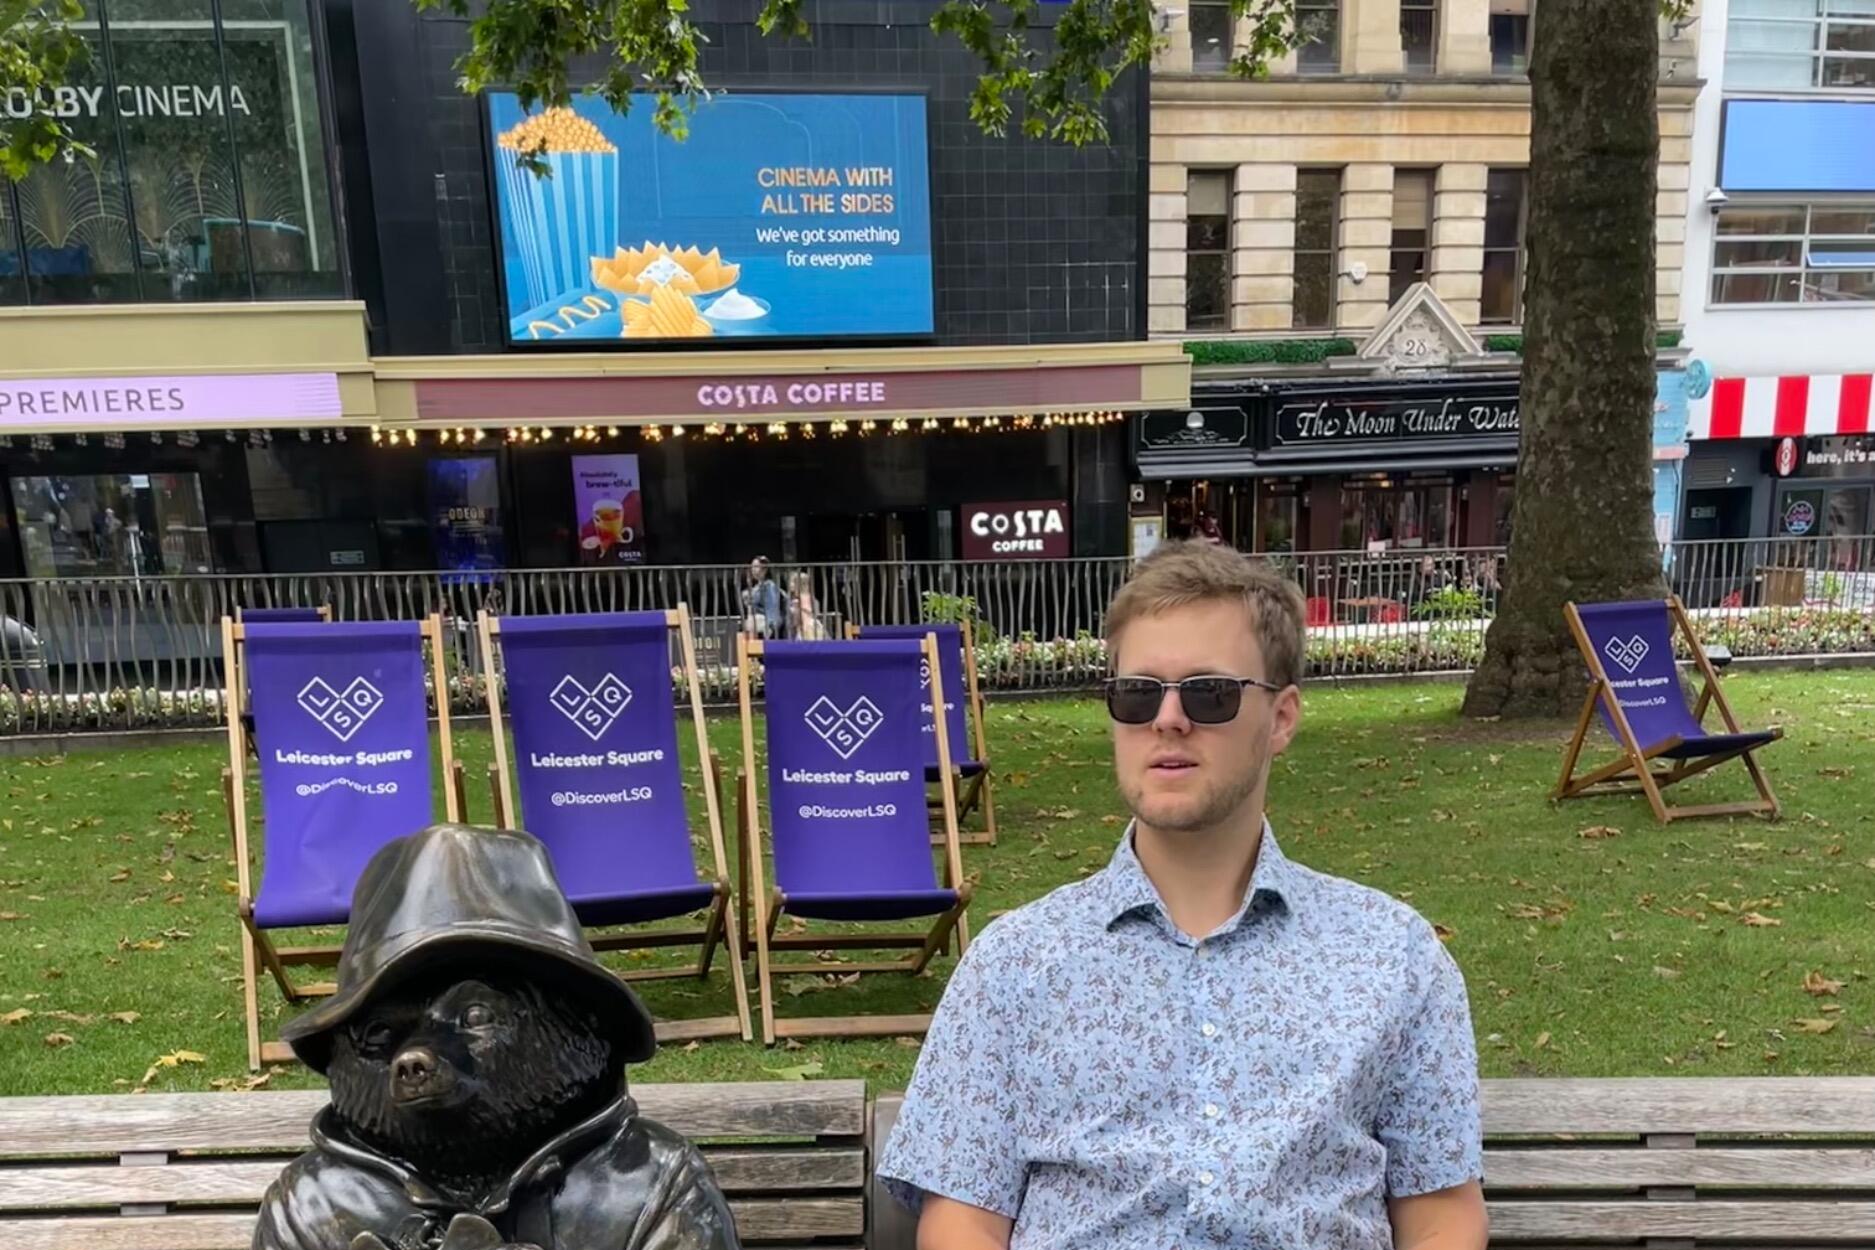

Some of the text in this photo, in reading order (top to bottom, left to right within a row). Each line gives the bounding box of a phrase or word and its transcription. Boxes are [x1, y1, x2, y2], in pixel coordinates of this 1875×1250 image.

[0, 85, 250, 119] OLBY CINEMA
[757, 167, 893, 188] CINEMA WITH
[761, 193, 894, 214] ALL THE SIDES
[756, 225, 900, 246] We've got something
[786, 250, 873, 270] for everyone
[0, 387, 184, 415] PREMIERES
[697, 382, 885, 408] COSTA COFFEE
[1296, 398, 1520, 437] The Moon Under Wate
[970, 509, 1064, 538] COSTA
[992, 539, 1044, 552] COFFEE
[275, 748, 413, 767] Leicester Square
[531, 749, 664, 767] Leicester Square
[782, 768, 910, 785] Leicester Square
[551, 786, 652, 806] @DiscoverLSQ
[799, 804, 896, 819] @DiscoverLSQ
